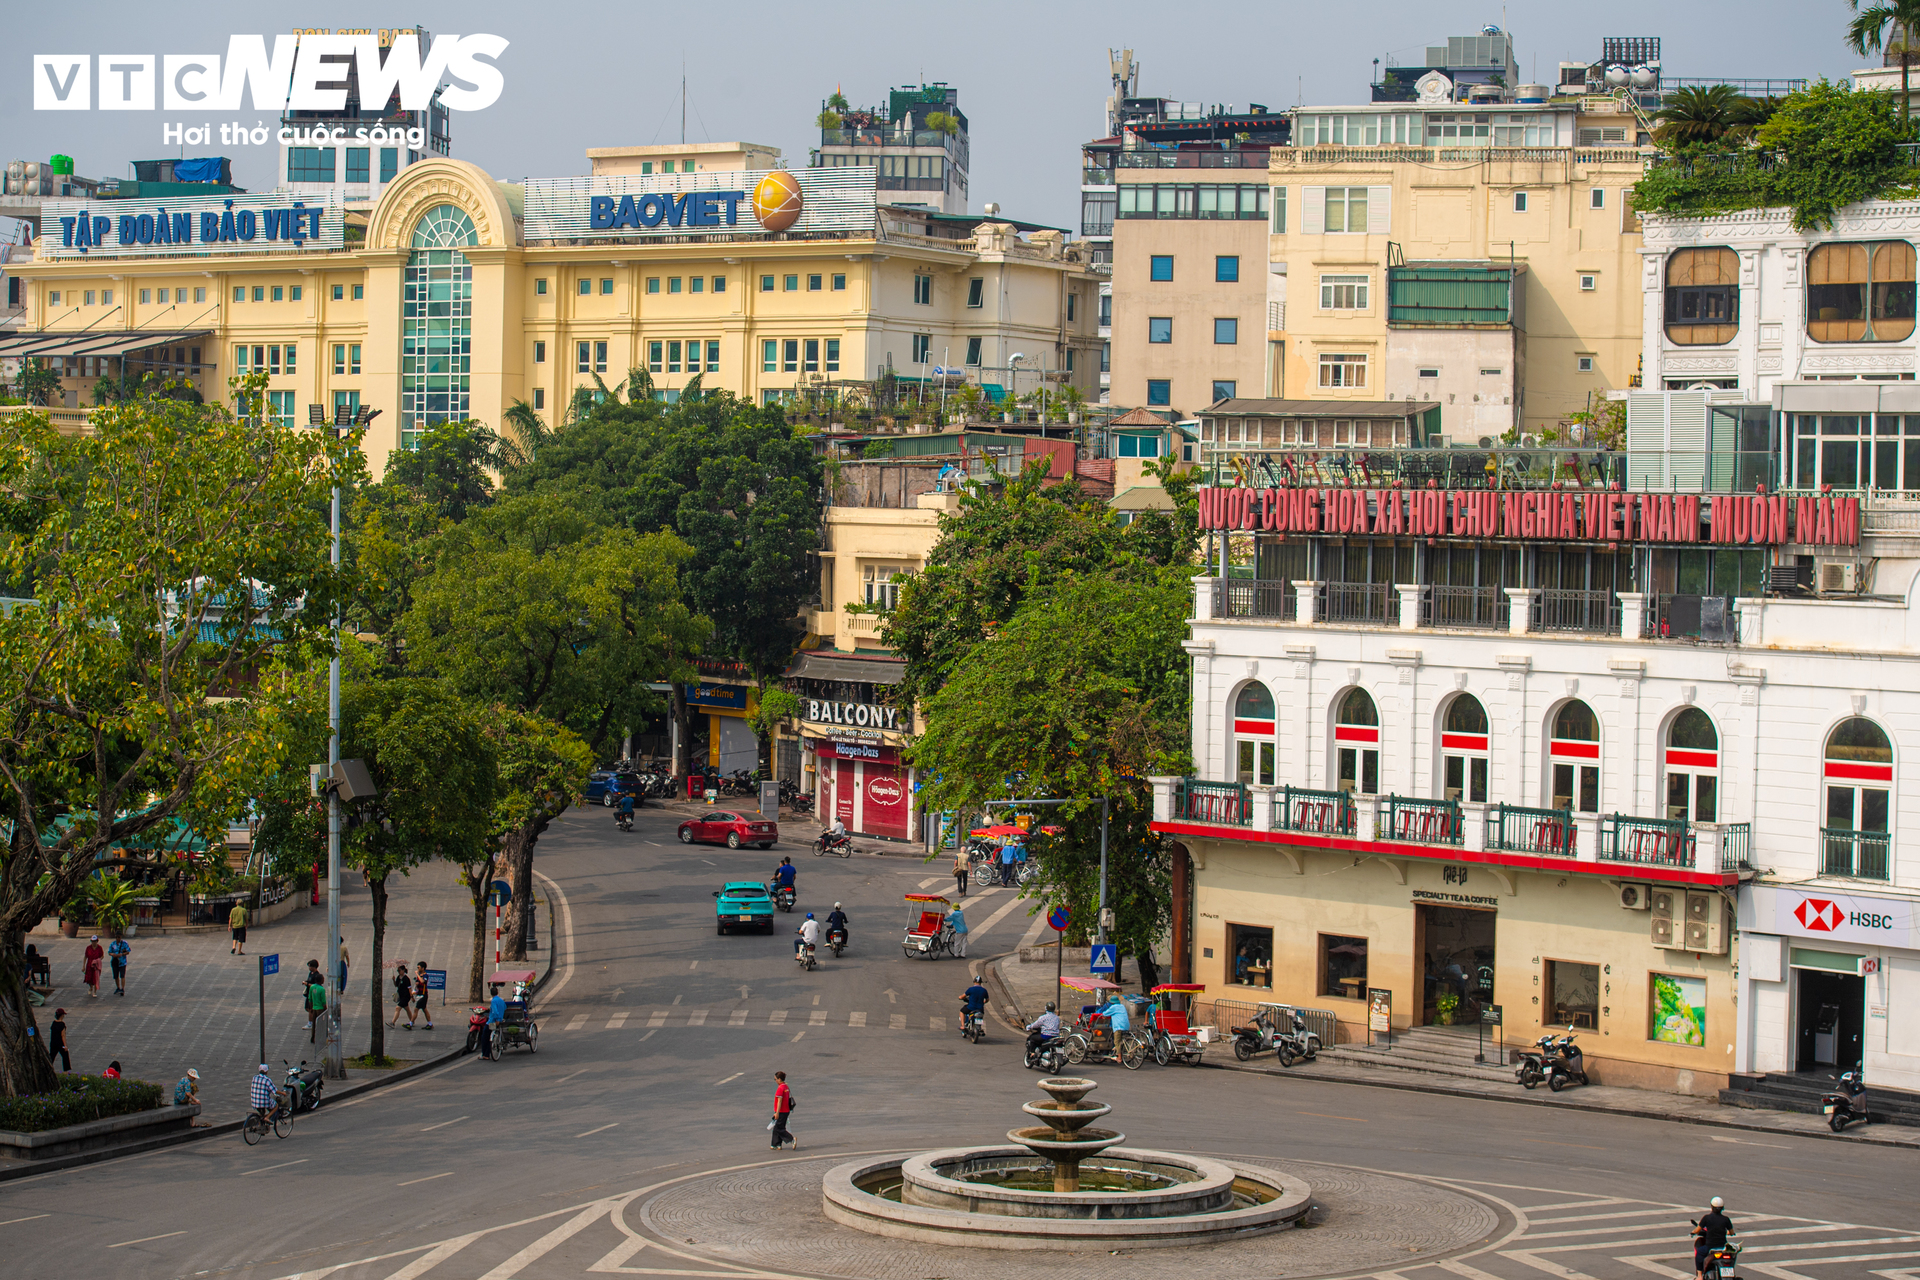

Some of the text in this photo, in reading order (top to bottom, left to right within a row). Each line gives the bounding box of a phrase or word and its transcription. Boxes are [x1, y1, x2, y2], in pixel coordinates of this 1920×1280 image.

[590, 191, 745, 229] BAOVIET
[60, 199, 324, 254] TẬP ĐOÀN BẢO VIỆT
[1640, 493, 1700, 542] NAM
[810, 700, 896, 728] BALCONY
[836, 742, 879, 758] Häagen-Dazs
[1412, 890, 1449, 900] SPECIALTY
[1450, 894, 1464, 902] TEA
[1471, 895, 1498, 905] COFFEE
[1850, 911, 1892, 929] HSBC
